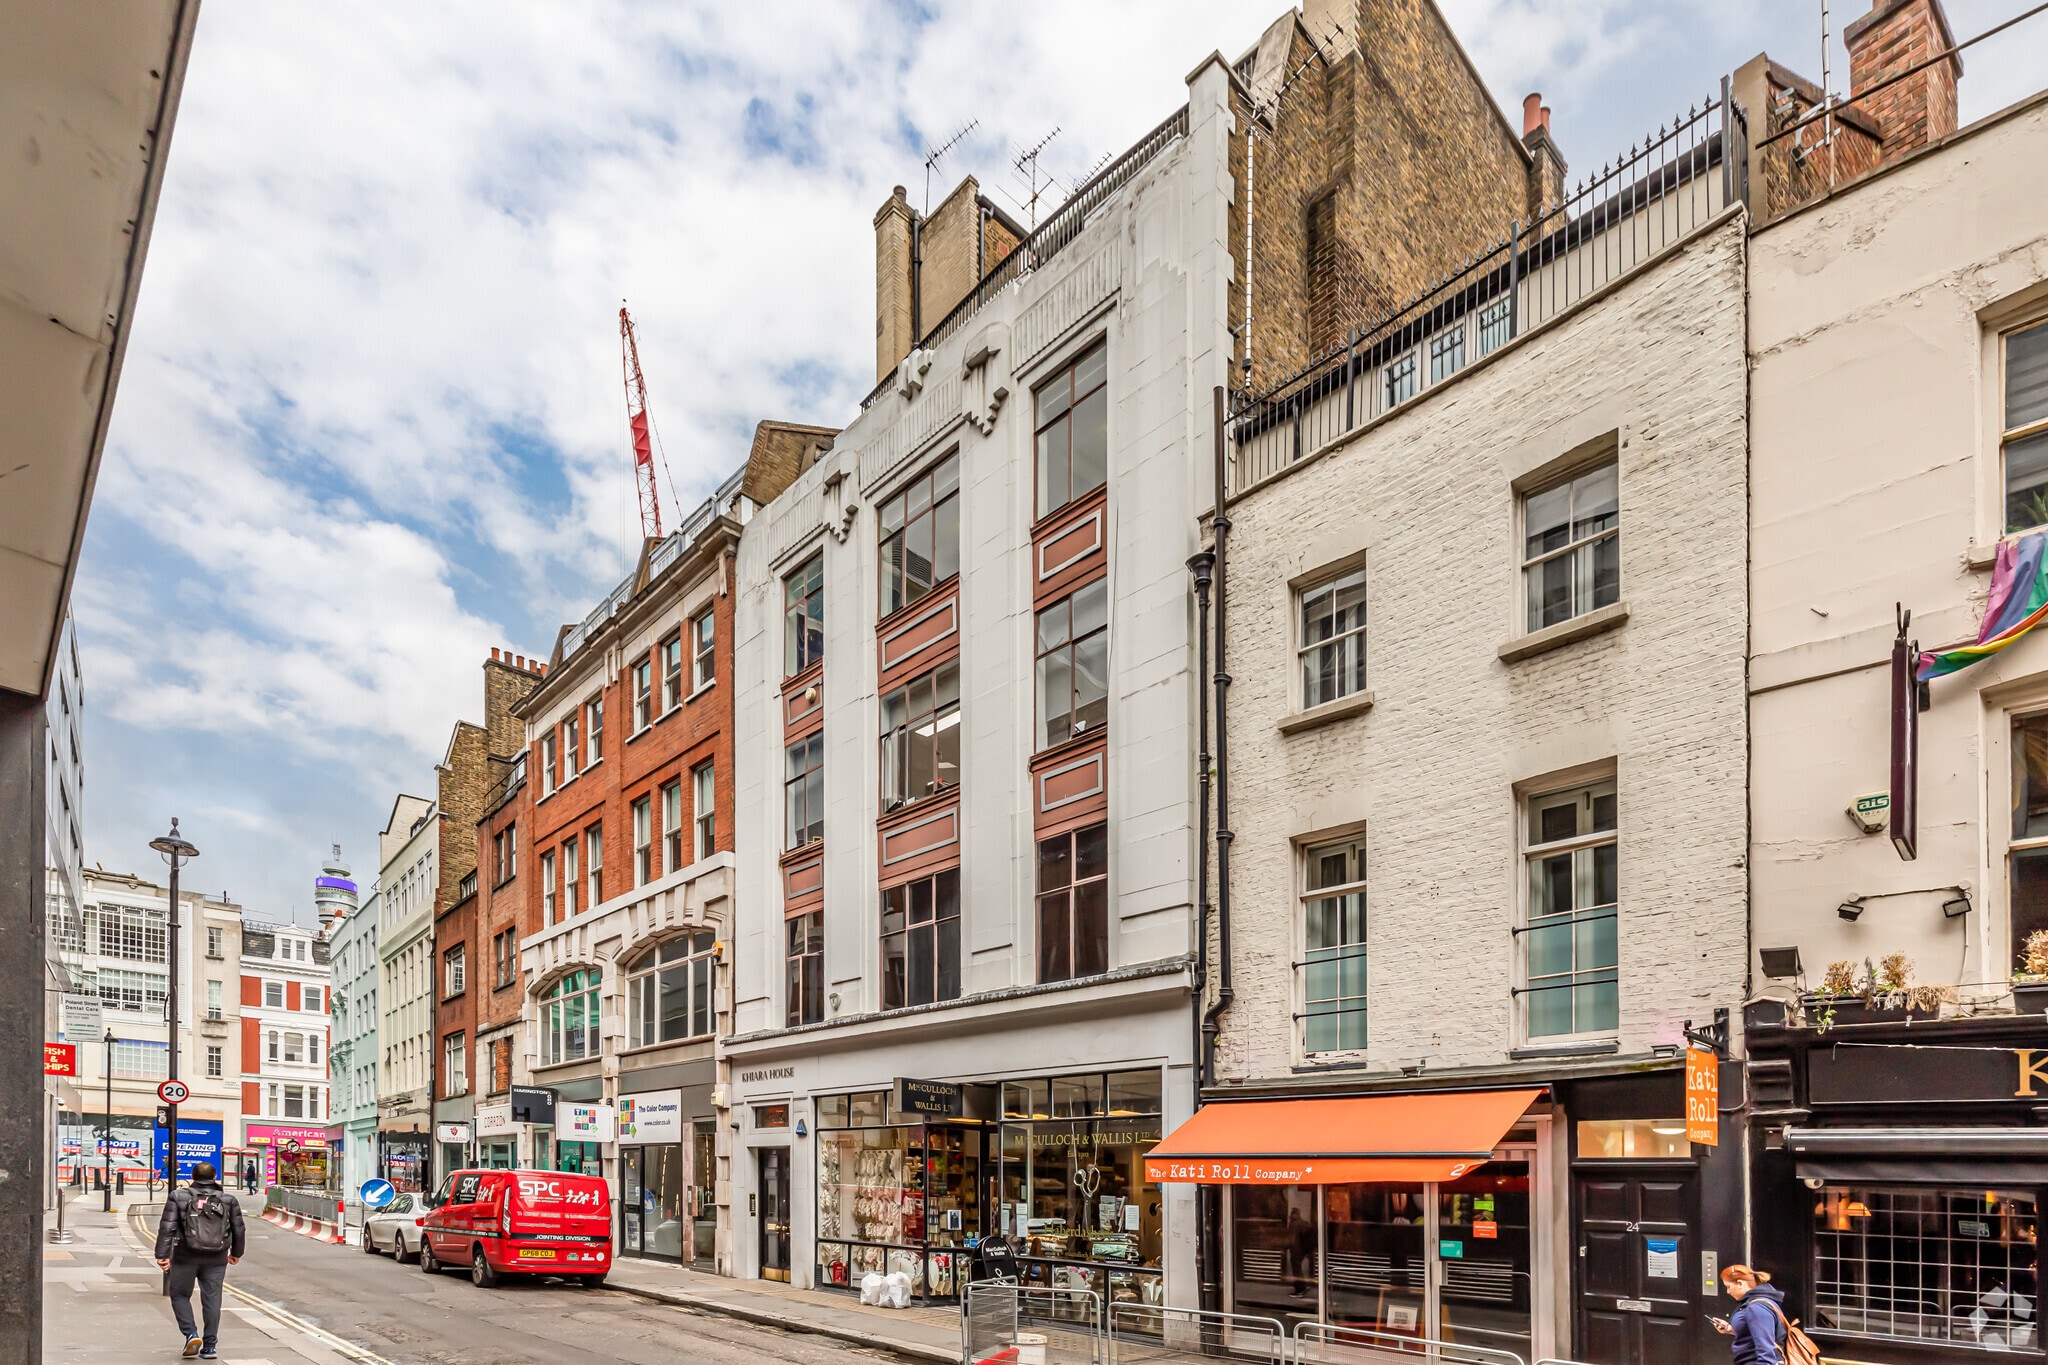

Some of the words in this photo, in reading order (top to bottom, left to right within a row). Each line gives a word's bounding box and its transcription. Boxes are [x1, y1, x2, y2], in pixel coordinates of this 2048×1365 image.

[1858, 797, 1889, 810] ais
[44, 1047, 66, 1056] FISH
[1687, 1051, 1697, 1061] The
[742, 1070, 769, 1083] KHIARA
[769, 1067, 795, 1080] HOUSE
[1688, 1066, 1718, 1093] Kati
[165, 1086, 185, 1097] 20
[638, 1105, 646, 1113] The
[646, 1104, 657, 1112] Color
[657, 1104, 678, 1112] Company
[914, 1101, 941, 1111] WALLIS
[1689, 1098, 1718, 1122] Roll
[273, 1128, 326, 1138] American
[1014, 1132, 1080, 1147] MCULLOCH
[1082, 1133, 1089, 1145] &
[1092, 1132, 1133, 1145] WALLIS
[1690, 1128, 1714, 1141] Company
[101, 1140, 137, 1148] SPORTS
[1150, 1168, 1167, 1177] The
[1169, 1164, 1206, 1178] Kati
[1211, 1164, 1251, 1179] Roll
[1255, 1169, 1303, 1180] Company
[461, 1177, 479, 1193] SPC
[518, 1180, 560, 1197] SPC
[1626, 1221, 1640, 1232] 24
